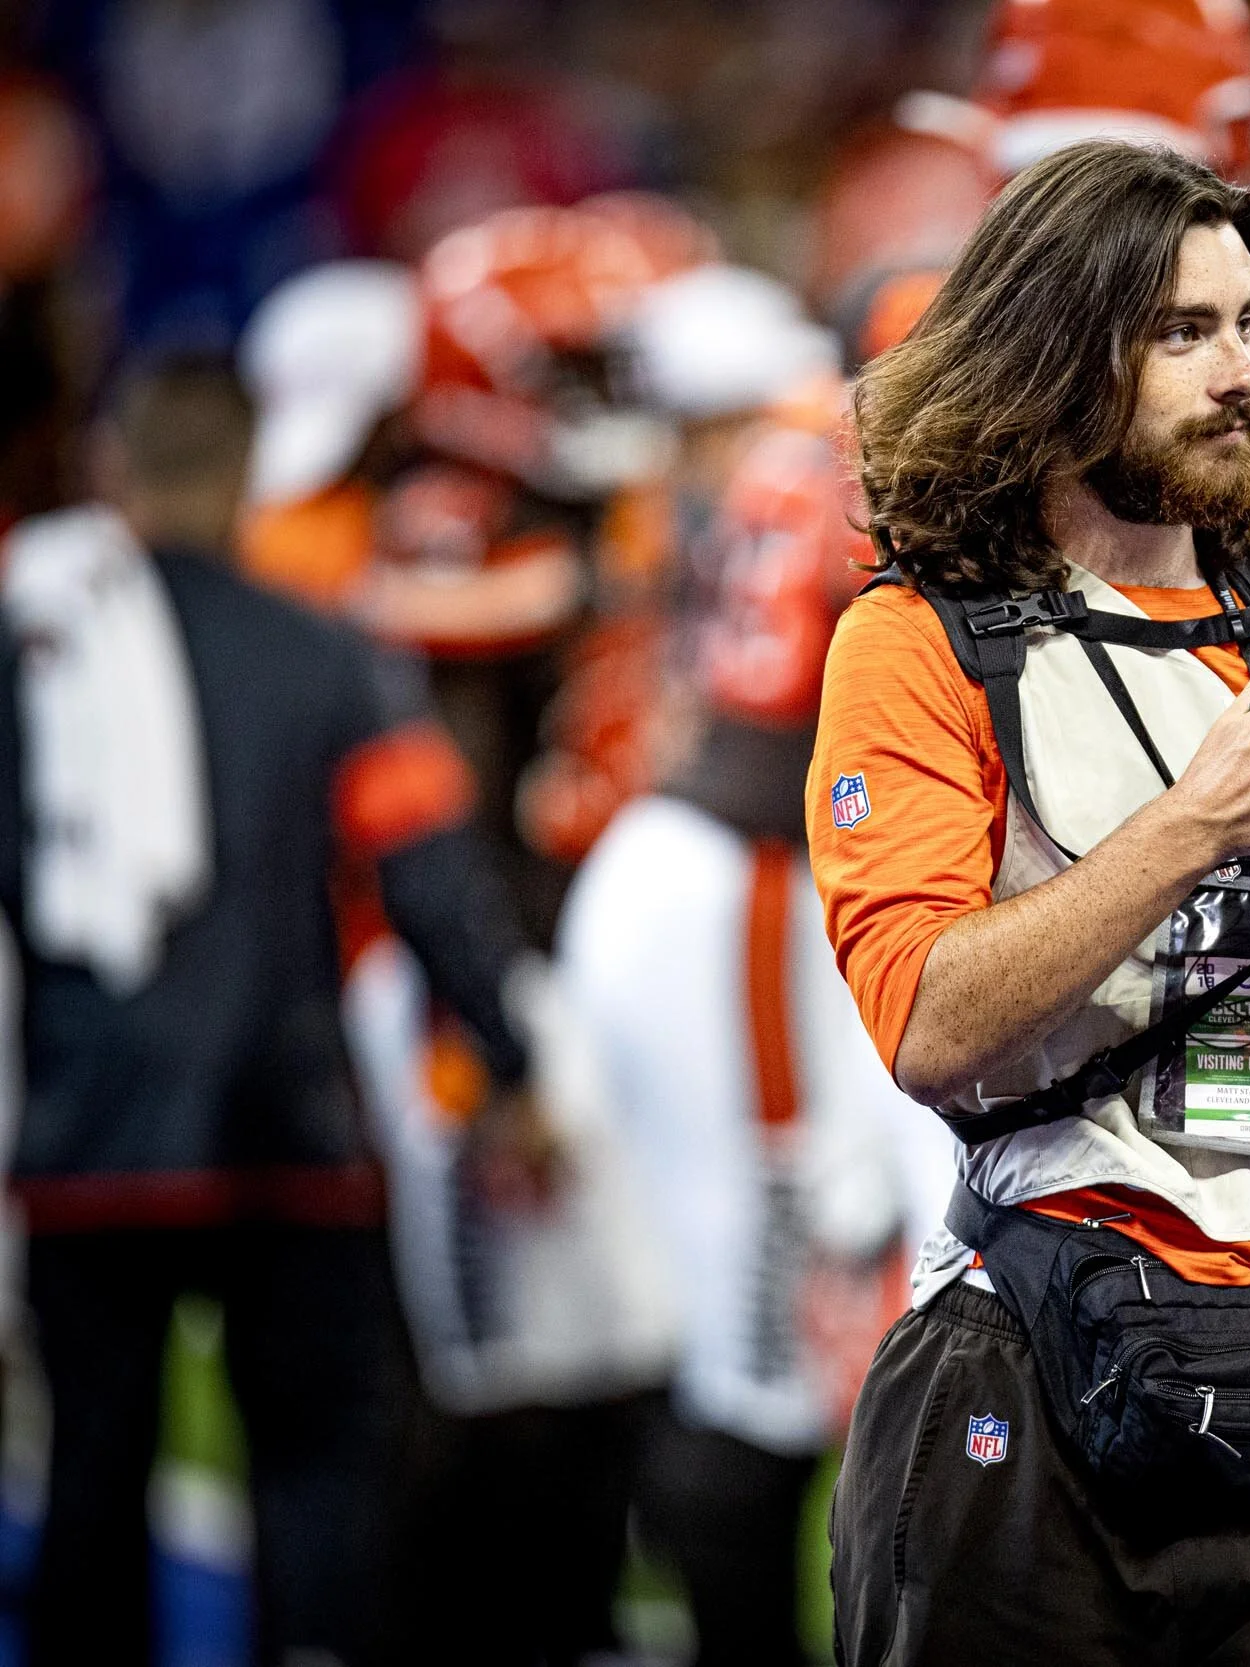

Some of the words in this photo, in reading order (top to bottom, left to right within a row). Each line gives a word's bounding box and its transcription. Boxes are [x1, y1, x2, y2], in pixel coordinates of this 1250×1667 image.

[834, 794, 865, 822] NFL
[1219, 865, 1239, 878] NFL
[1196, 963, 1215, 975] 20
[1197, 1053, 1244, 1071] VISITING
[1217, 1087, 1238, 1095] MATT
[1207, 1096, 1250, 1105] CLEVELAND
[972, 1435, 1001, 1458] NFL
